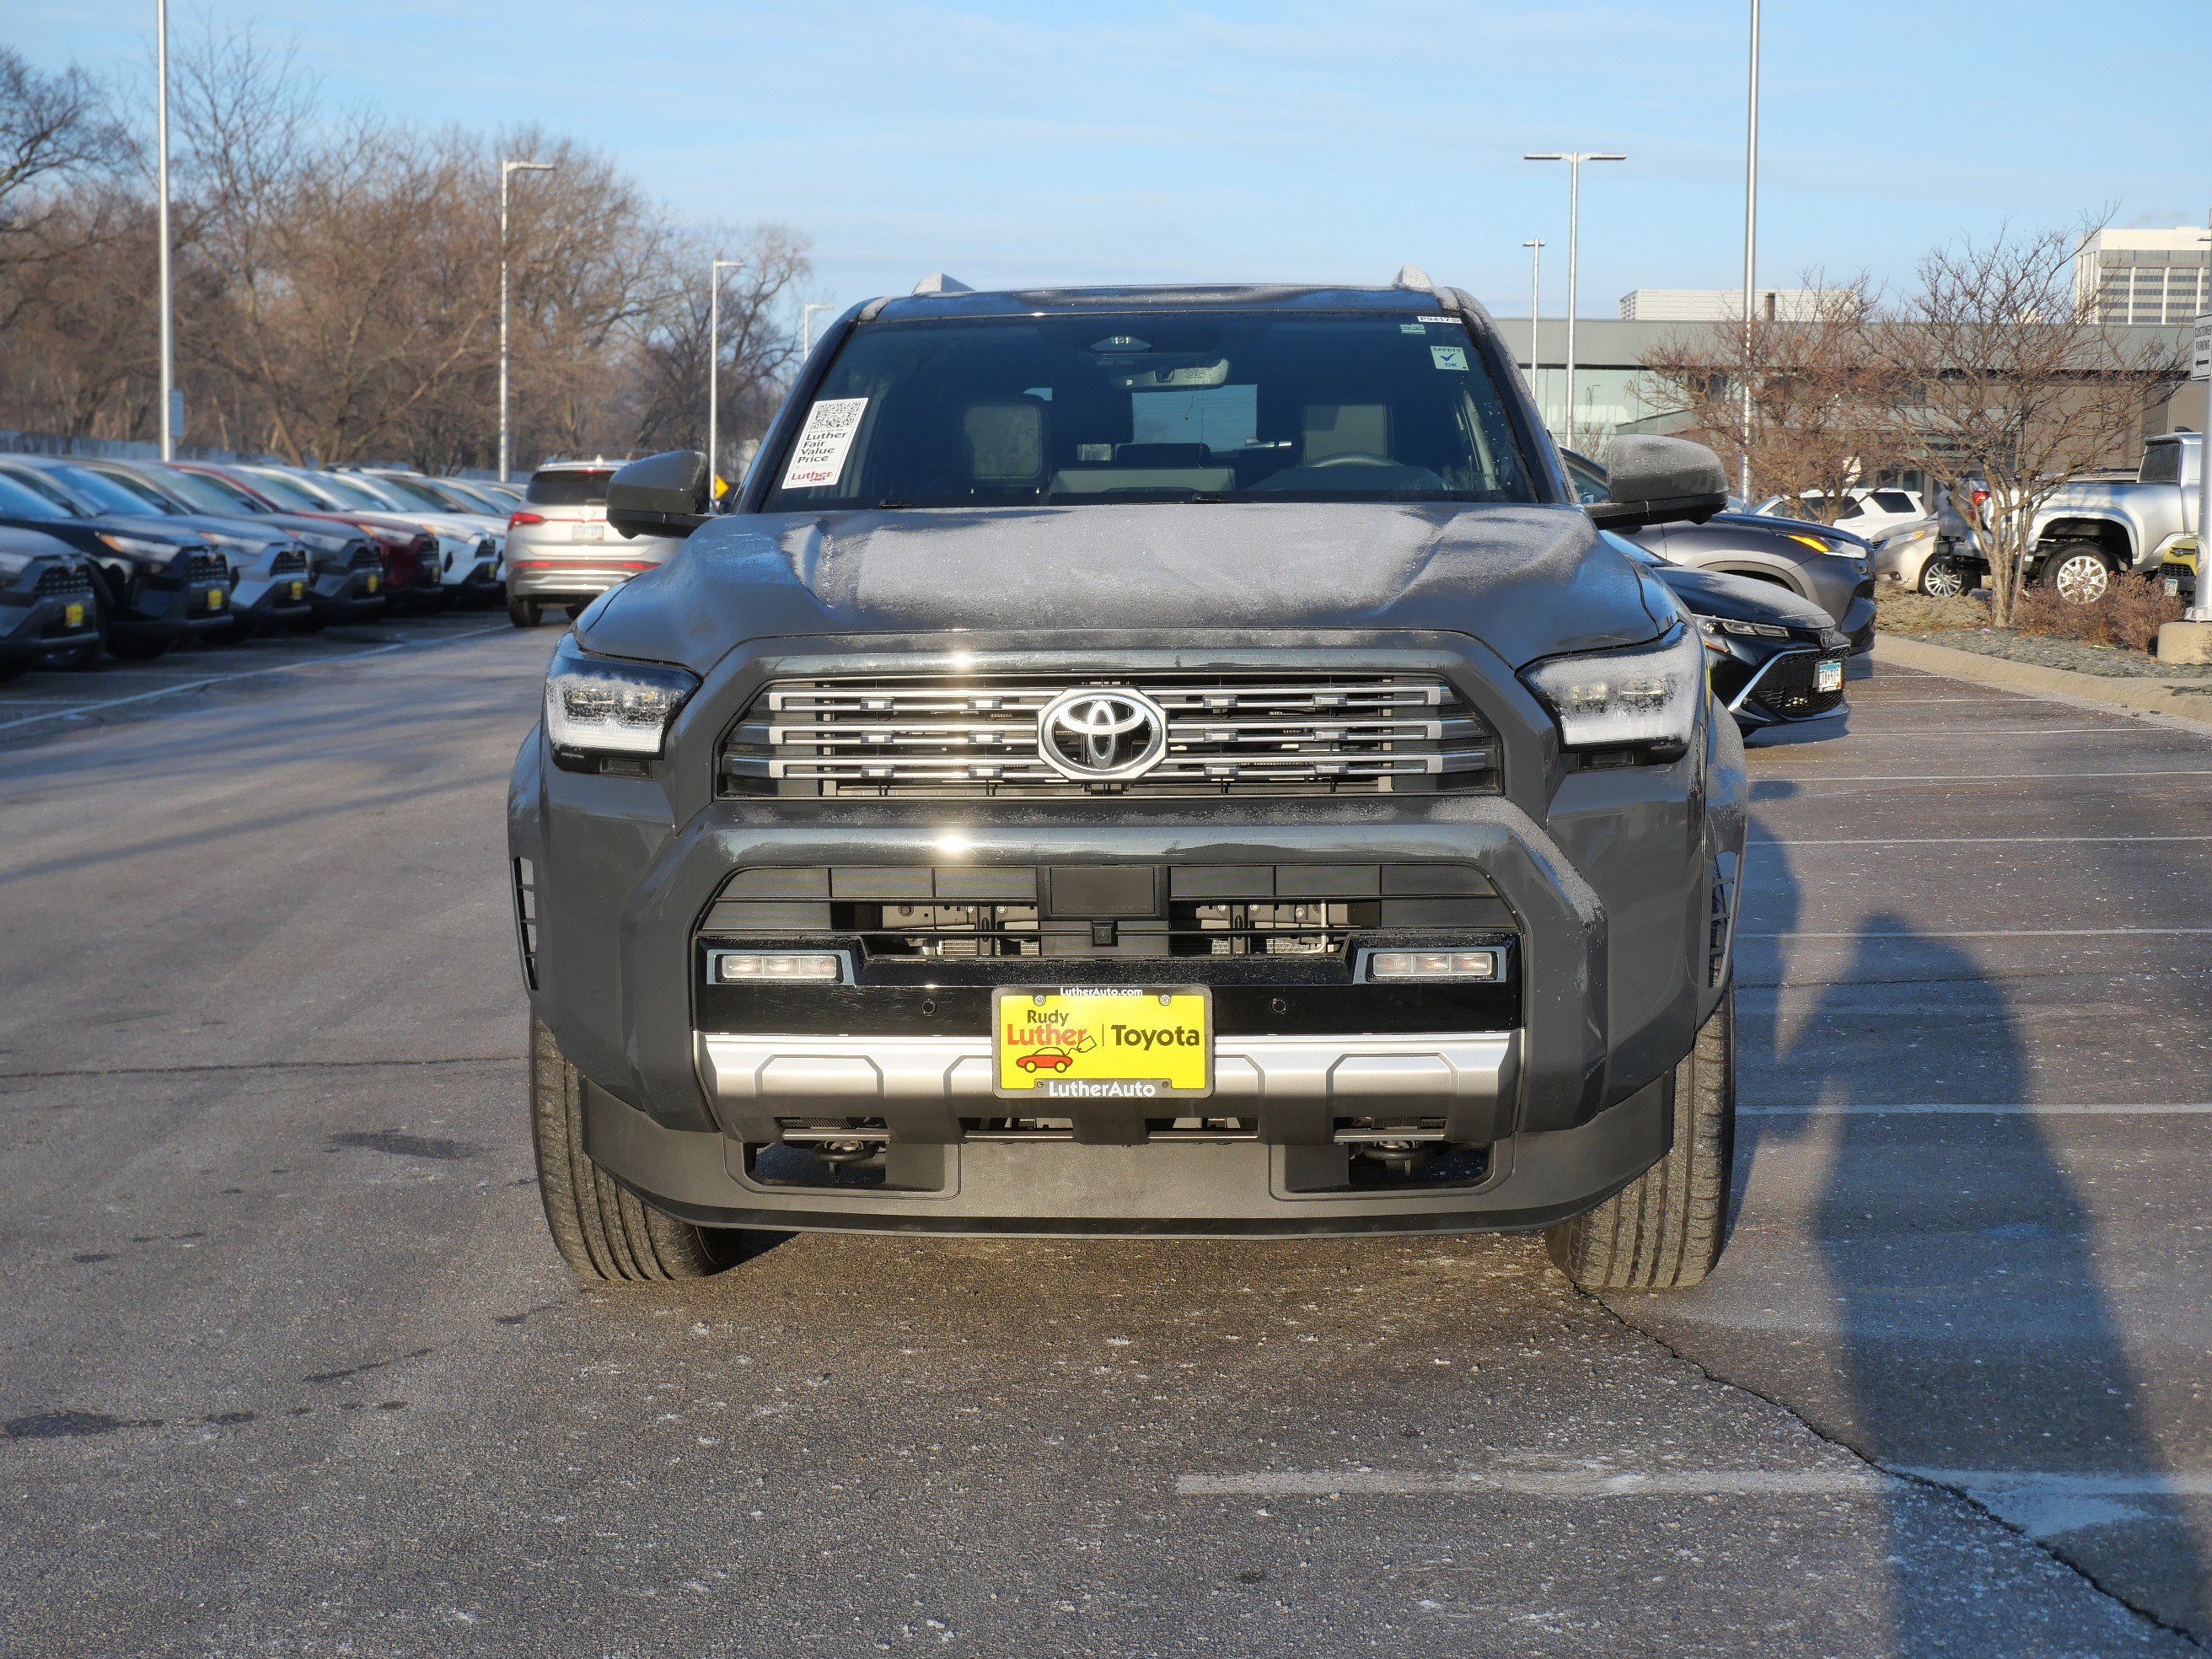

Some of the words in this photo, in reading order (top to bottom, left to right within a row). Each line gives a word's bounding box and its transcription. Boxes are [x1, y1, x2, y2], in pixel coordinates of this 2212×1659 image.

[806, 432, 847, 440] Luther
[803, 440, 826, 448] Fair
[797, 455, 830, 464] Price
[791, 471, 833, 481] Luther
[1060, 987, 1143, 996] LutherAuto.com
[1027, 1009, 1069, 1027] Rudy
[1007, 1023, 1087, 1046] Luther
[1110, 1024, 1200, 1051] Toyota
[1049, 1081, 1157, 1098] LutherAuto
